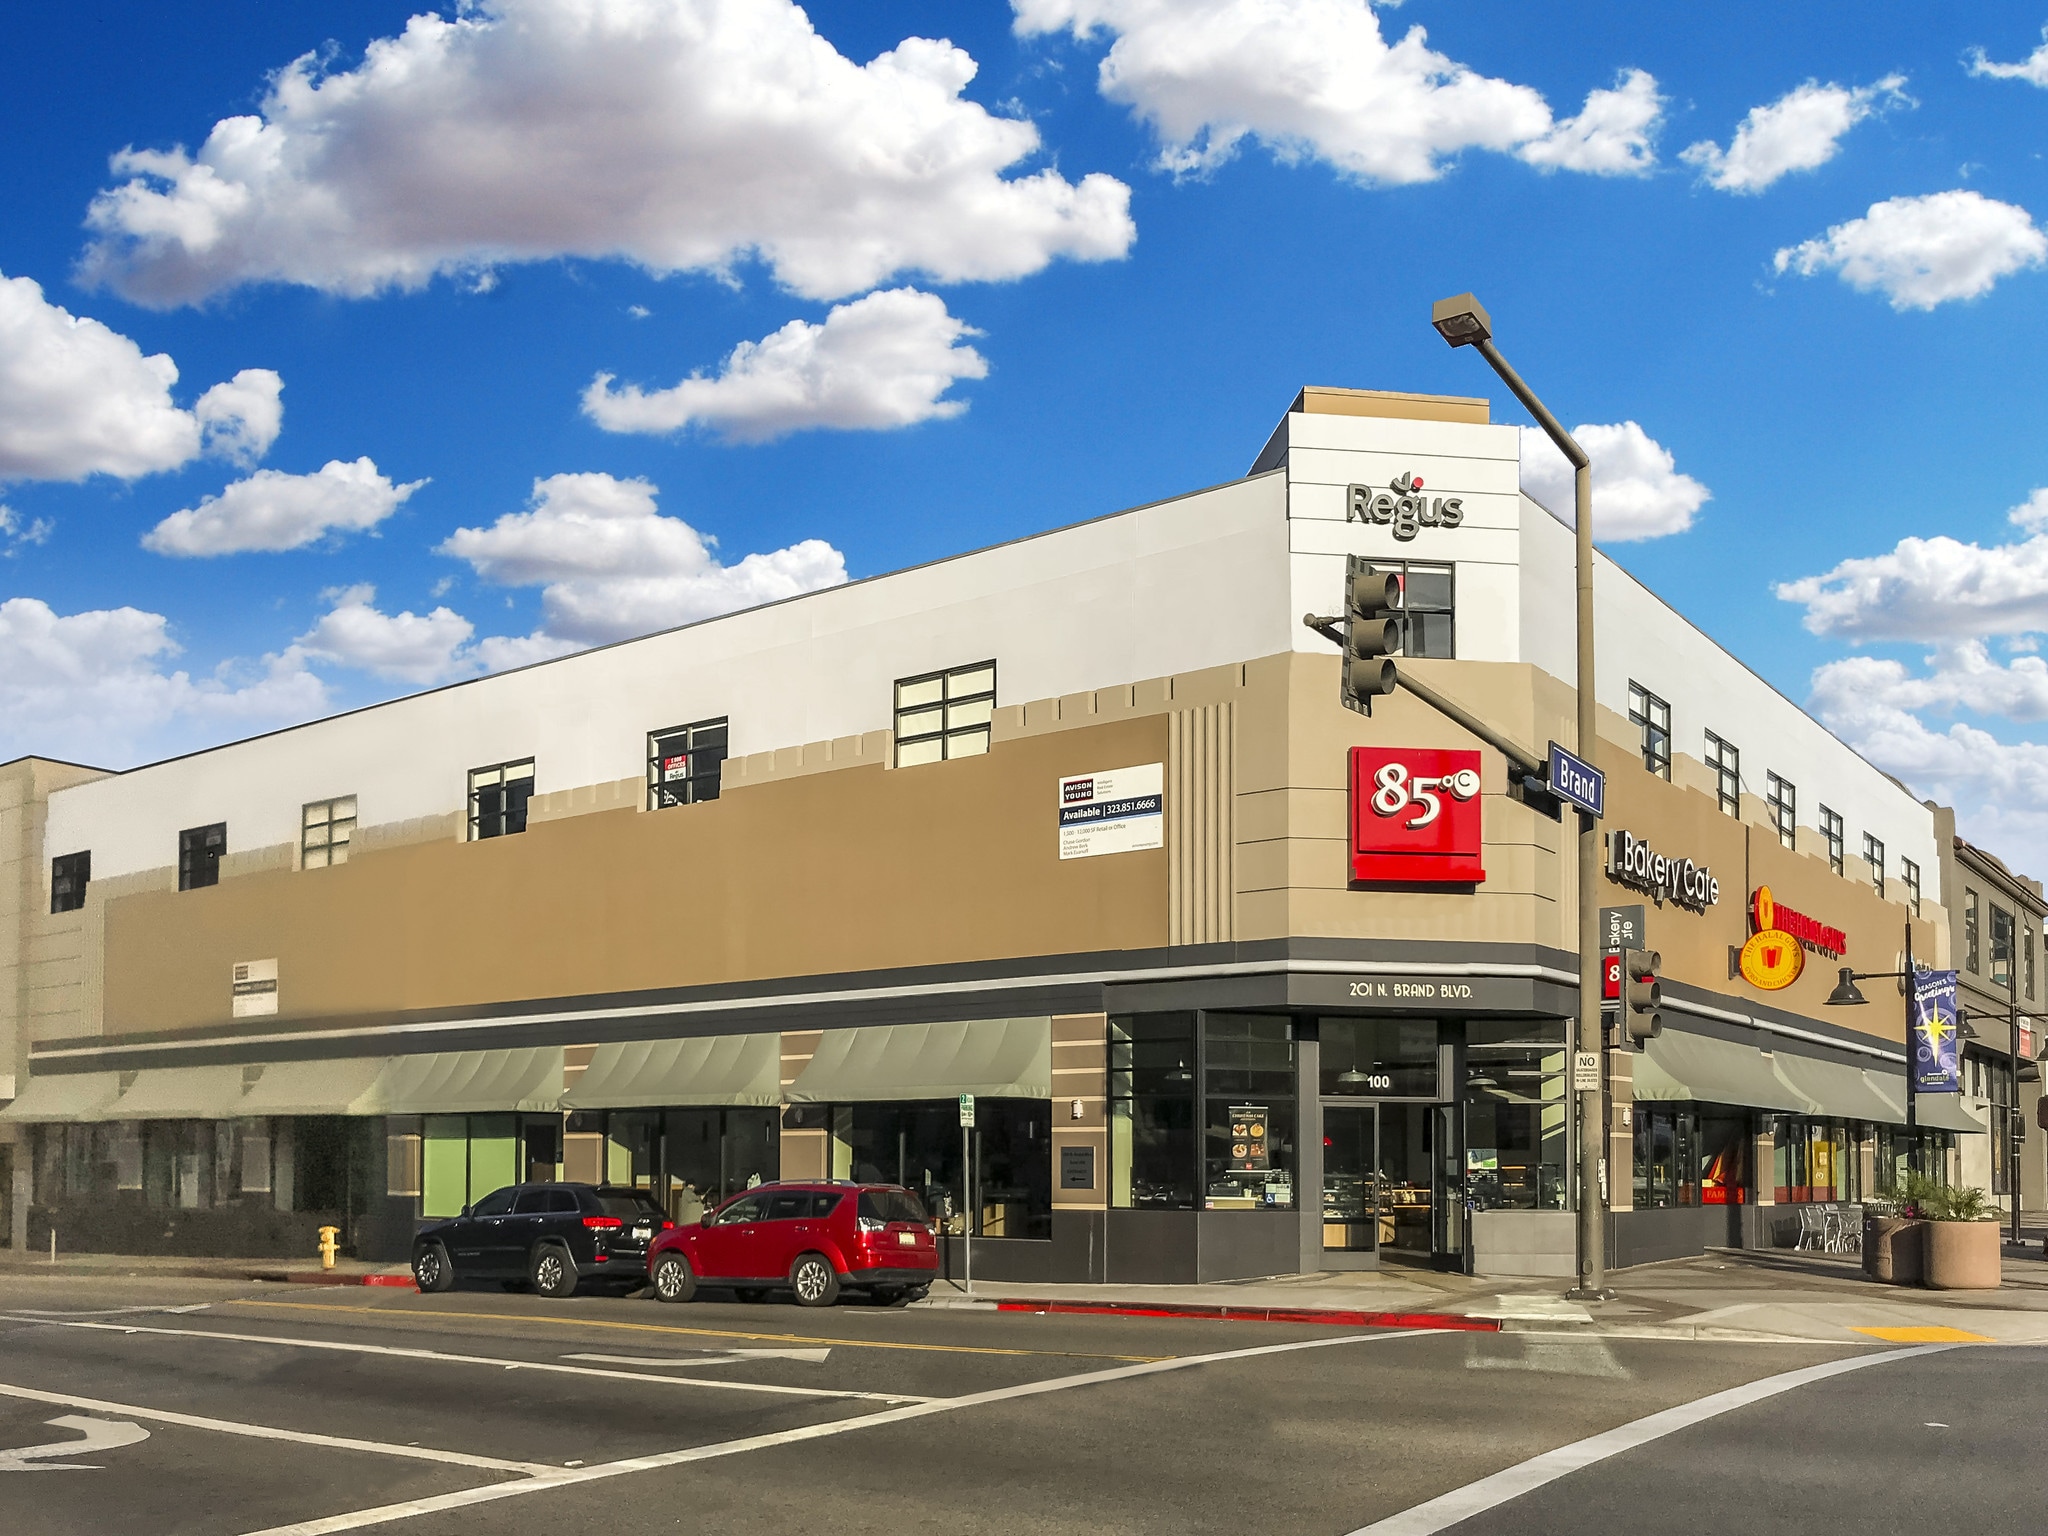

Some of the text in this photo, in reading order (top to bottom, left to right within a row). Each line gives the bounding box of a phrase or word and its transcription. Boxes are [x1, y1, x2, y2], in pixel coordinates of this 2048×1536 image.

[1347, 483, 1463, 541] Regus
[1064, 782, 1092, 792] AVISON
[1561, 758, 1595, 804] Brand
[1064, 791, 1092, 801] YOUNG
[1063, 798, 1156, 820] Available 323.851.6666
[1625, 830, 1719, 905] Bakery Cafe
[1609, 911, 1623, 953] Bakery
[1349, 982, 1473, 998] 201 N. BRAND BLVD.
[1914, 985, 1955, 1001] Greetings
[1579, 1057, 1595, 1066] NO
[1367, 1075, 1390, 1089] 100
